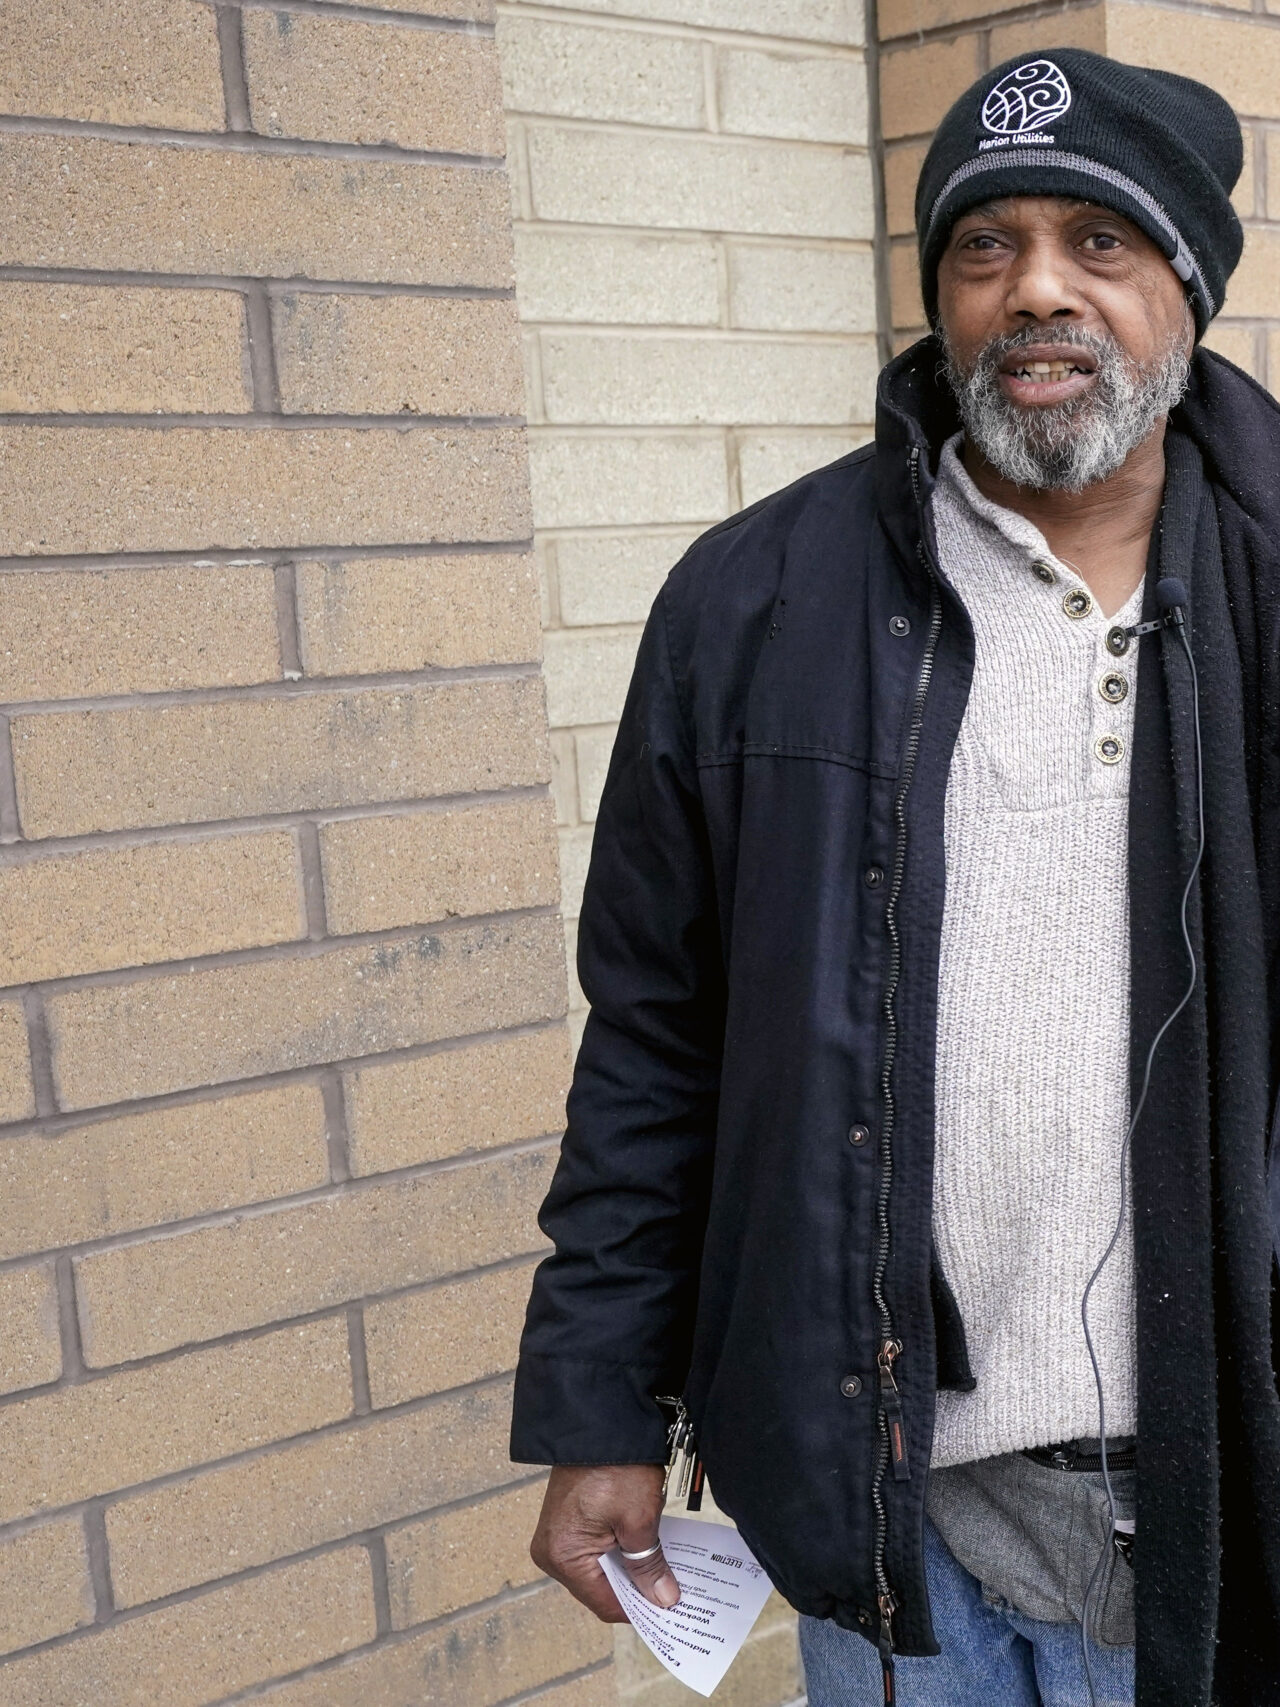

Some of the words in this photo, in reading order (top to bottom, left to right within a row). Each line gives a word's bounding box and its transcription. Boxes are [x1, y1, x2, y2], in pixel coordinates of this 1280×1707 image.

[978, 136, 1010, 151] Marion
[1012, 131, 1055, 144] Utilities
[710, 1553, 743, 1569] ELECTION
[694, 1585, 707, 1593] ends
[674, 1622, 690, 1632] Feb.
[670, 1635, 711, 1655] Midtown
